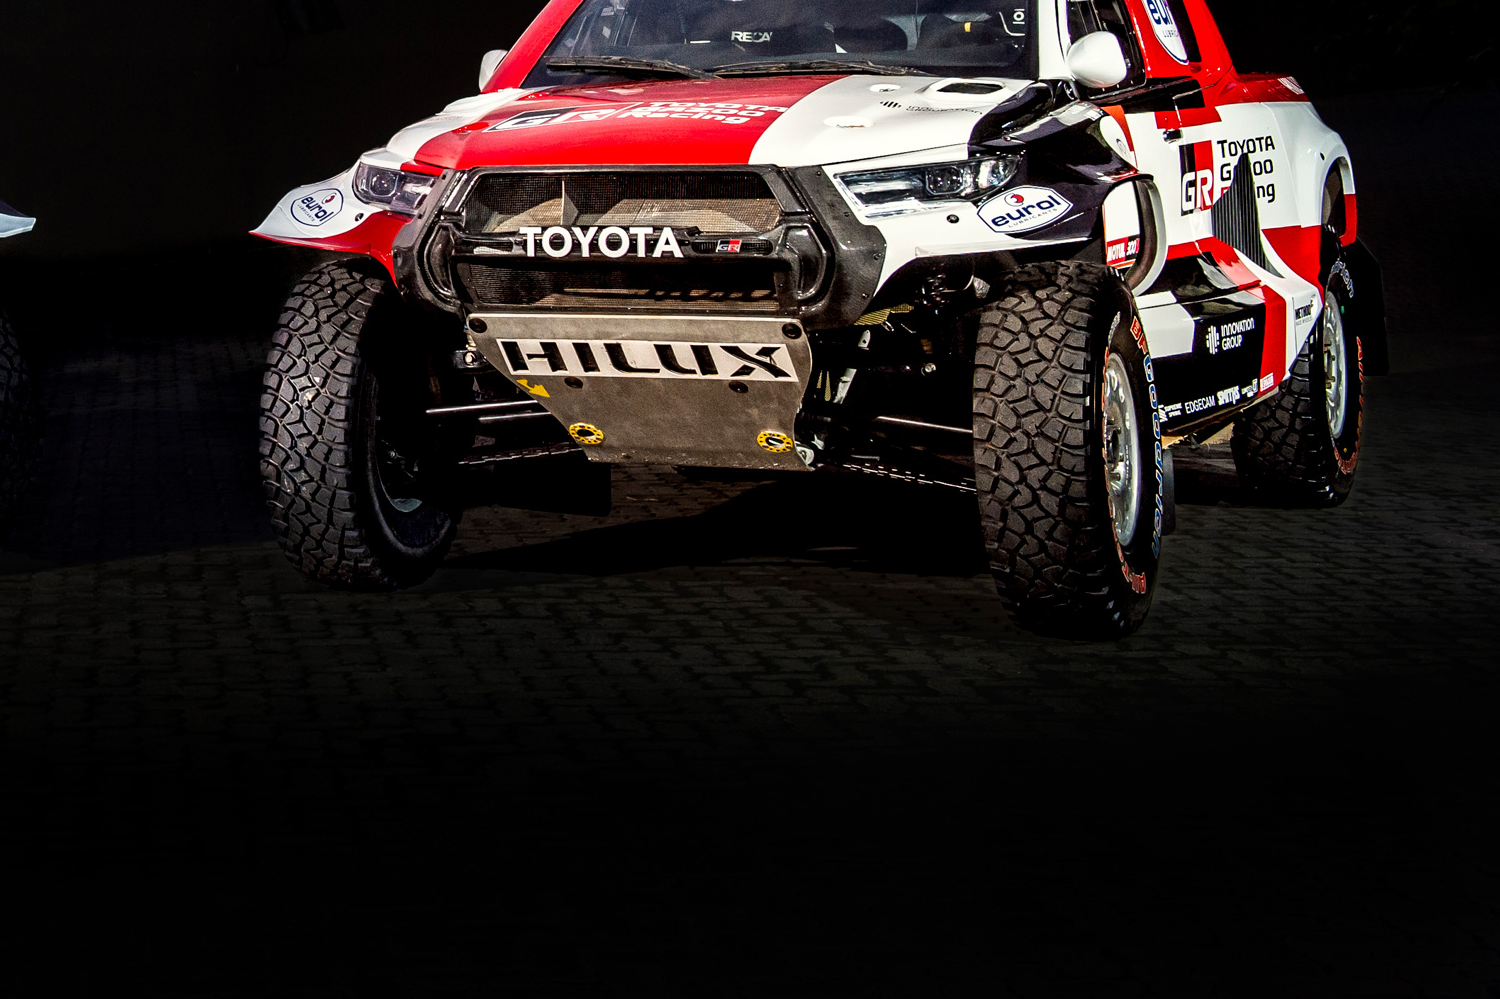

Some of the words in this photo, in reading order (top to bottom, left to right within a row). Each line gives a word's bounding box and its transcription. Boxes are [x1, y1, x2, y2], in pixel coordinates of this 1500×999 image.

[617, 111, 750, 124] Racing
[650, 102, 788, 112] TOYOTA
[1217, 135, 1276, 158] TOYOTA
[1220, 159, 1274, 182] GOO
[301, 196, 334, 222] eurol
[991, 195, 1062, 227] eurol
[519, 226, 684, 258] TOYOTA
[1221, 318, 1255, 337] INNOVATION
[1222, 334, 1243, 351] GROUP
[501, 341, 792, 378] HILUX
[1185, 395, 1215, 414] EDGECAM
